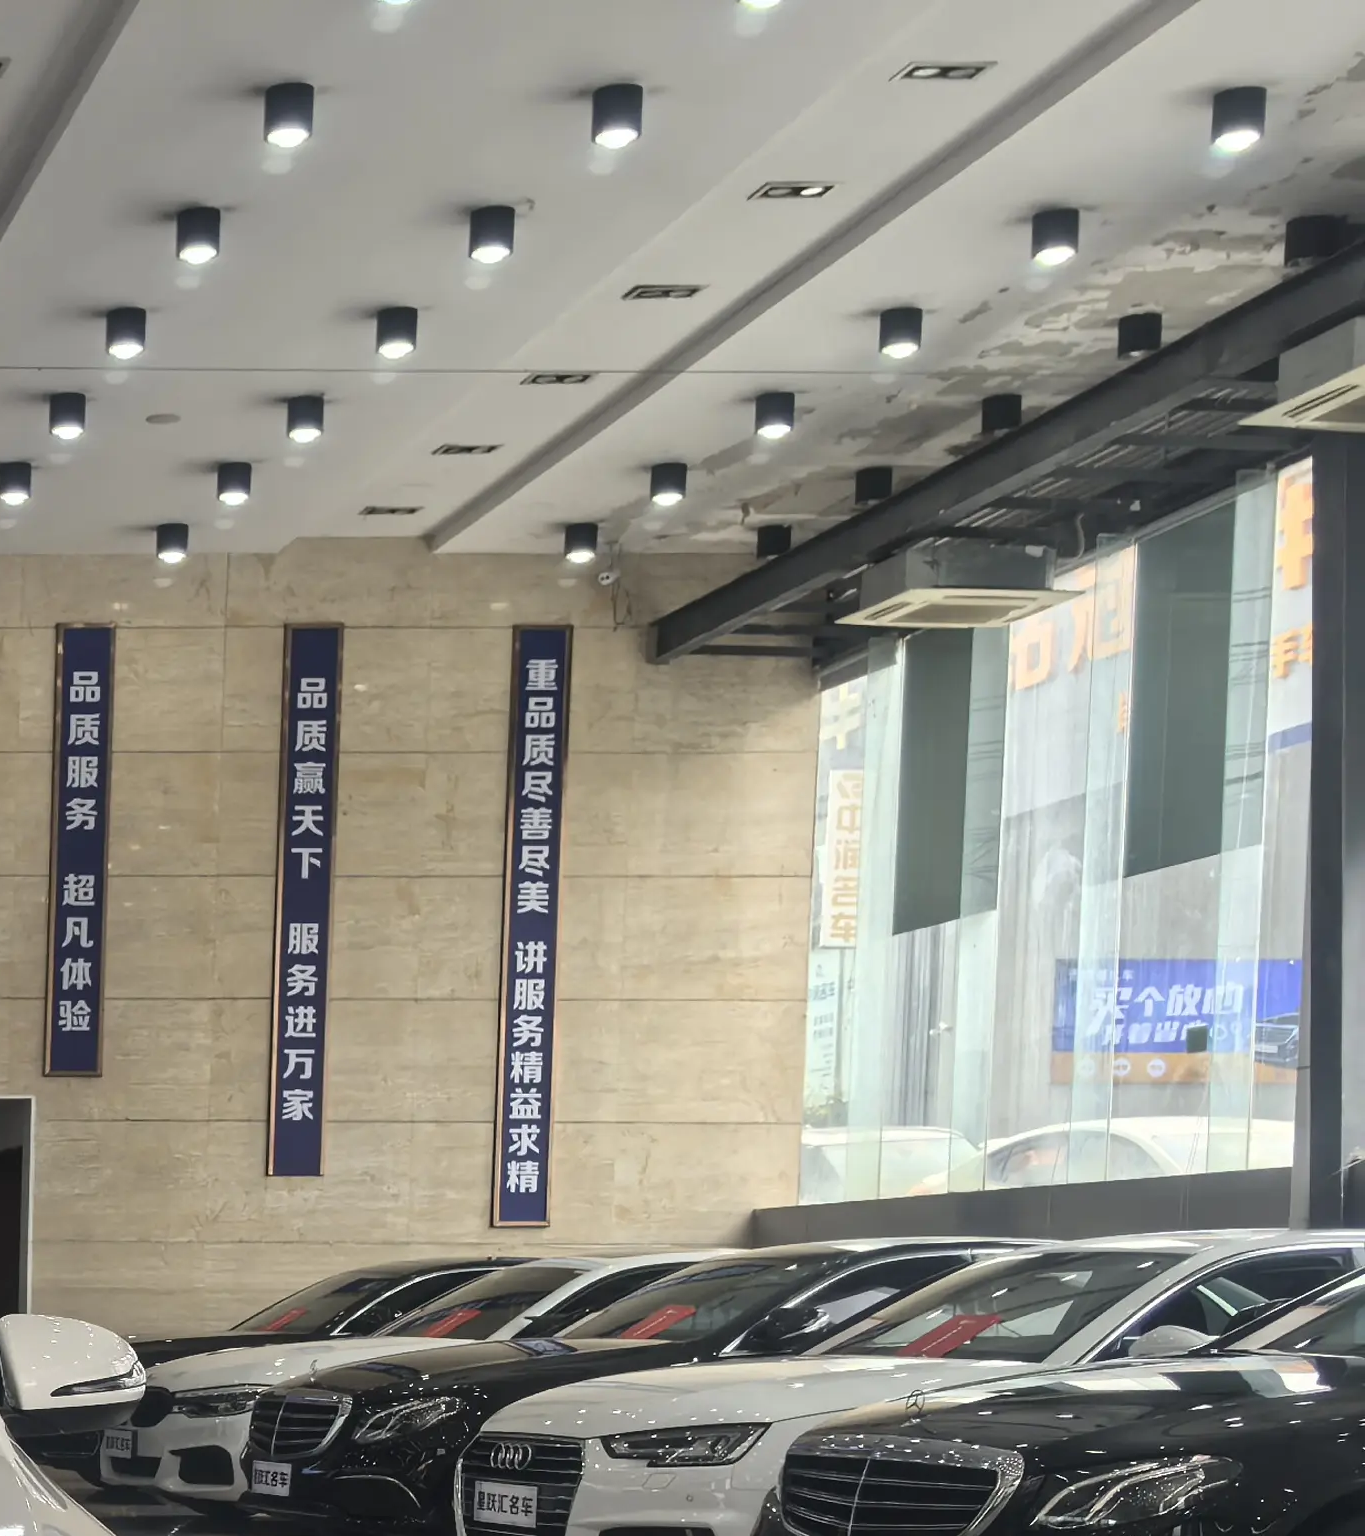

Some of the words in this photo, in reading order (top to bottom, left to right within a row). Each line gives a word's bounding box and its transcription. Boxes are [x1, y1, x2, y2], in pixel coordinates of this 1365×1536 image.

[65, 670, 101, 832] 品质服务
[290, 677, 329, 880] 品质赢天下
[516, 658, 559, 914] 重品质尽善尽美
[58, 872, 96, 1033] 超凡体验
[281, 922, 320, 1121] 服务进万家
[506, 941, 548, 1194] 讲服务精益求精
[477, 1490, 534, 1517] 星跃汇名车
